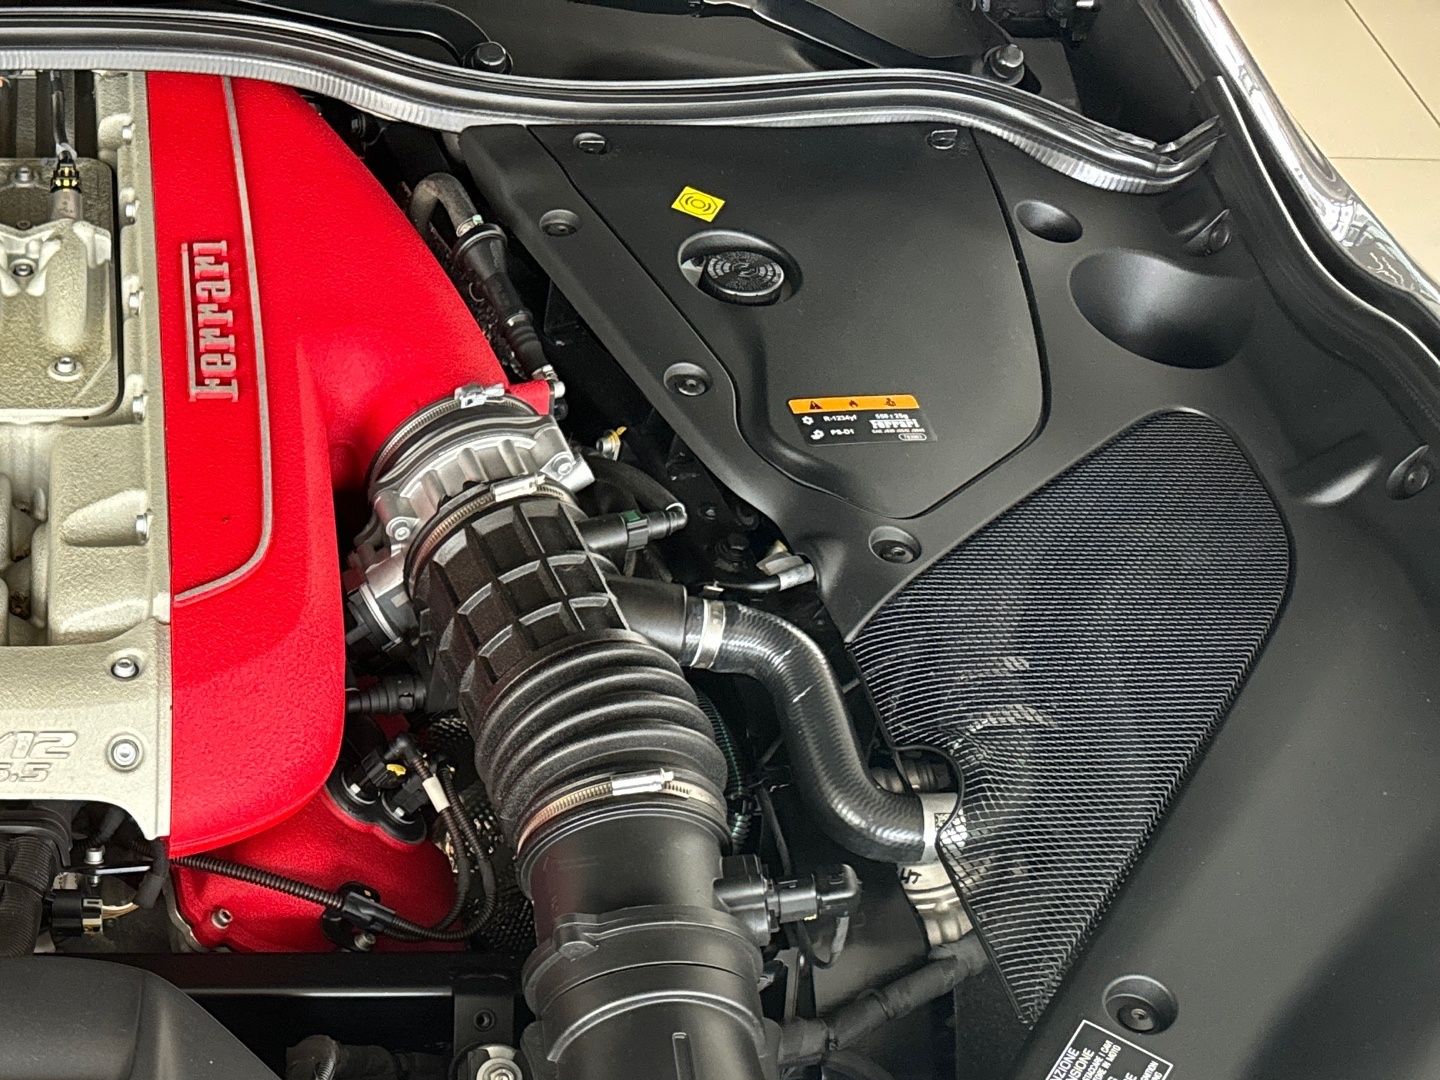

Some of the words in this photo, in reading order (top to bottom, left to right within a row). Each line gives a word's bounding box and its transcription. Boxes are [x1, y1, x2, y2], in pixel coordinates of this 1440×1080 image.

[181, 240, 240, 403] Ferrari
[868, 418, 921, 430] Ferrari
[1101, 1040, 1113, 1053] CAVI
[1106, 1045, 1121, 1062] MOTO
